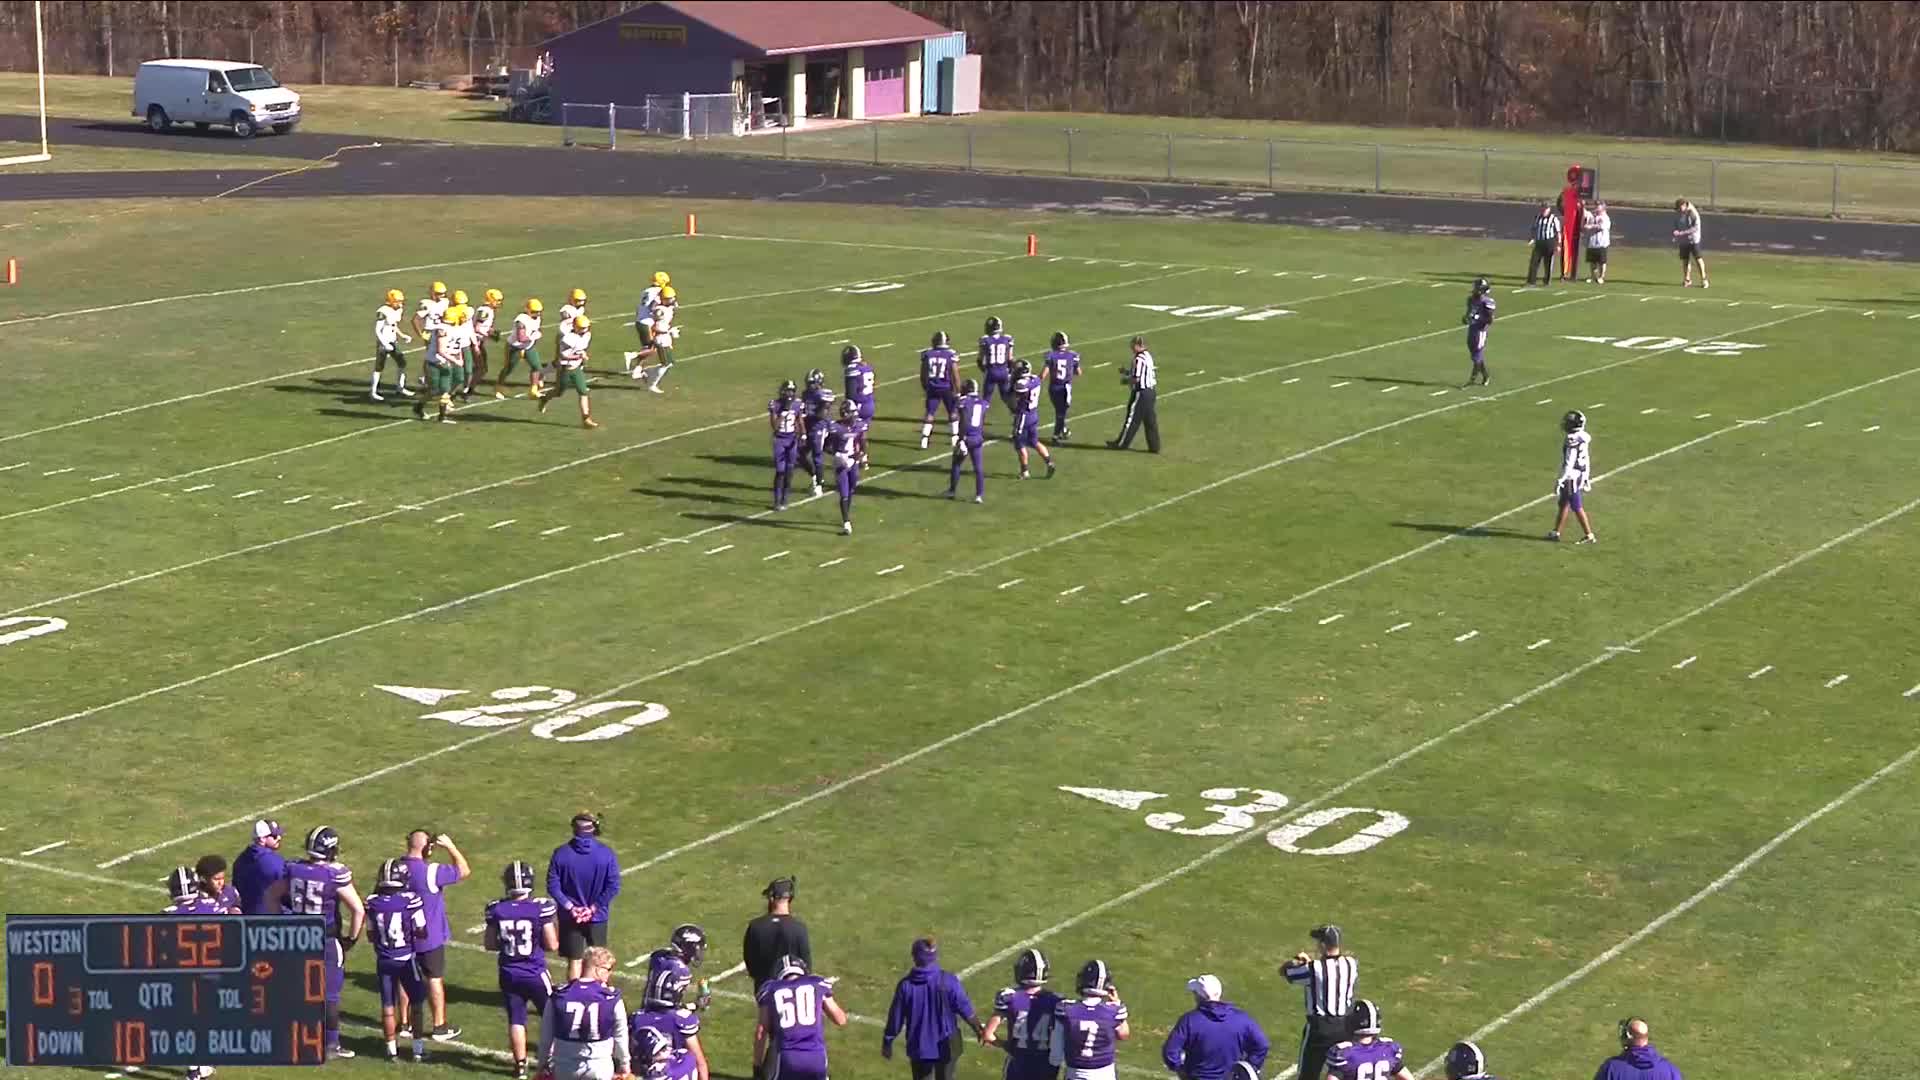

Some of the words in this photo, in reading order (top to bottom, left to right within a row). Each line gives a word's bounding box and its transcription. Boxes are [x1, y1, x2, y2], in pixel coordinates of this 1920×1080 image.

[1056, 359, 1067, 380] 5
[418, 685, 670, 743] 20
[1145, 787, 1410, 856] 30
[289, 878, 325, 915] 65
[375, 912, 407, 948] 14
[499, 919, 534, 957] 53
[565, 1001, 600, 1041] 71
[774, 985, 817, 1029] 60
[1012, 1011, 1051, 1050] 44
[1079, 1020, 1099, 1058] 7
